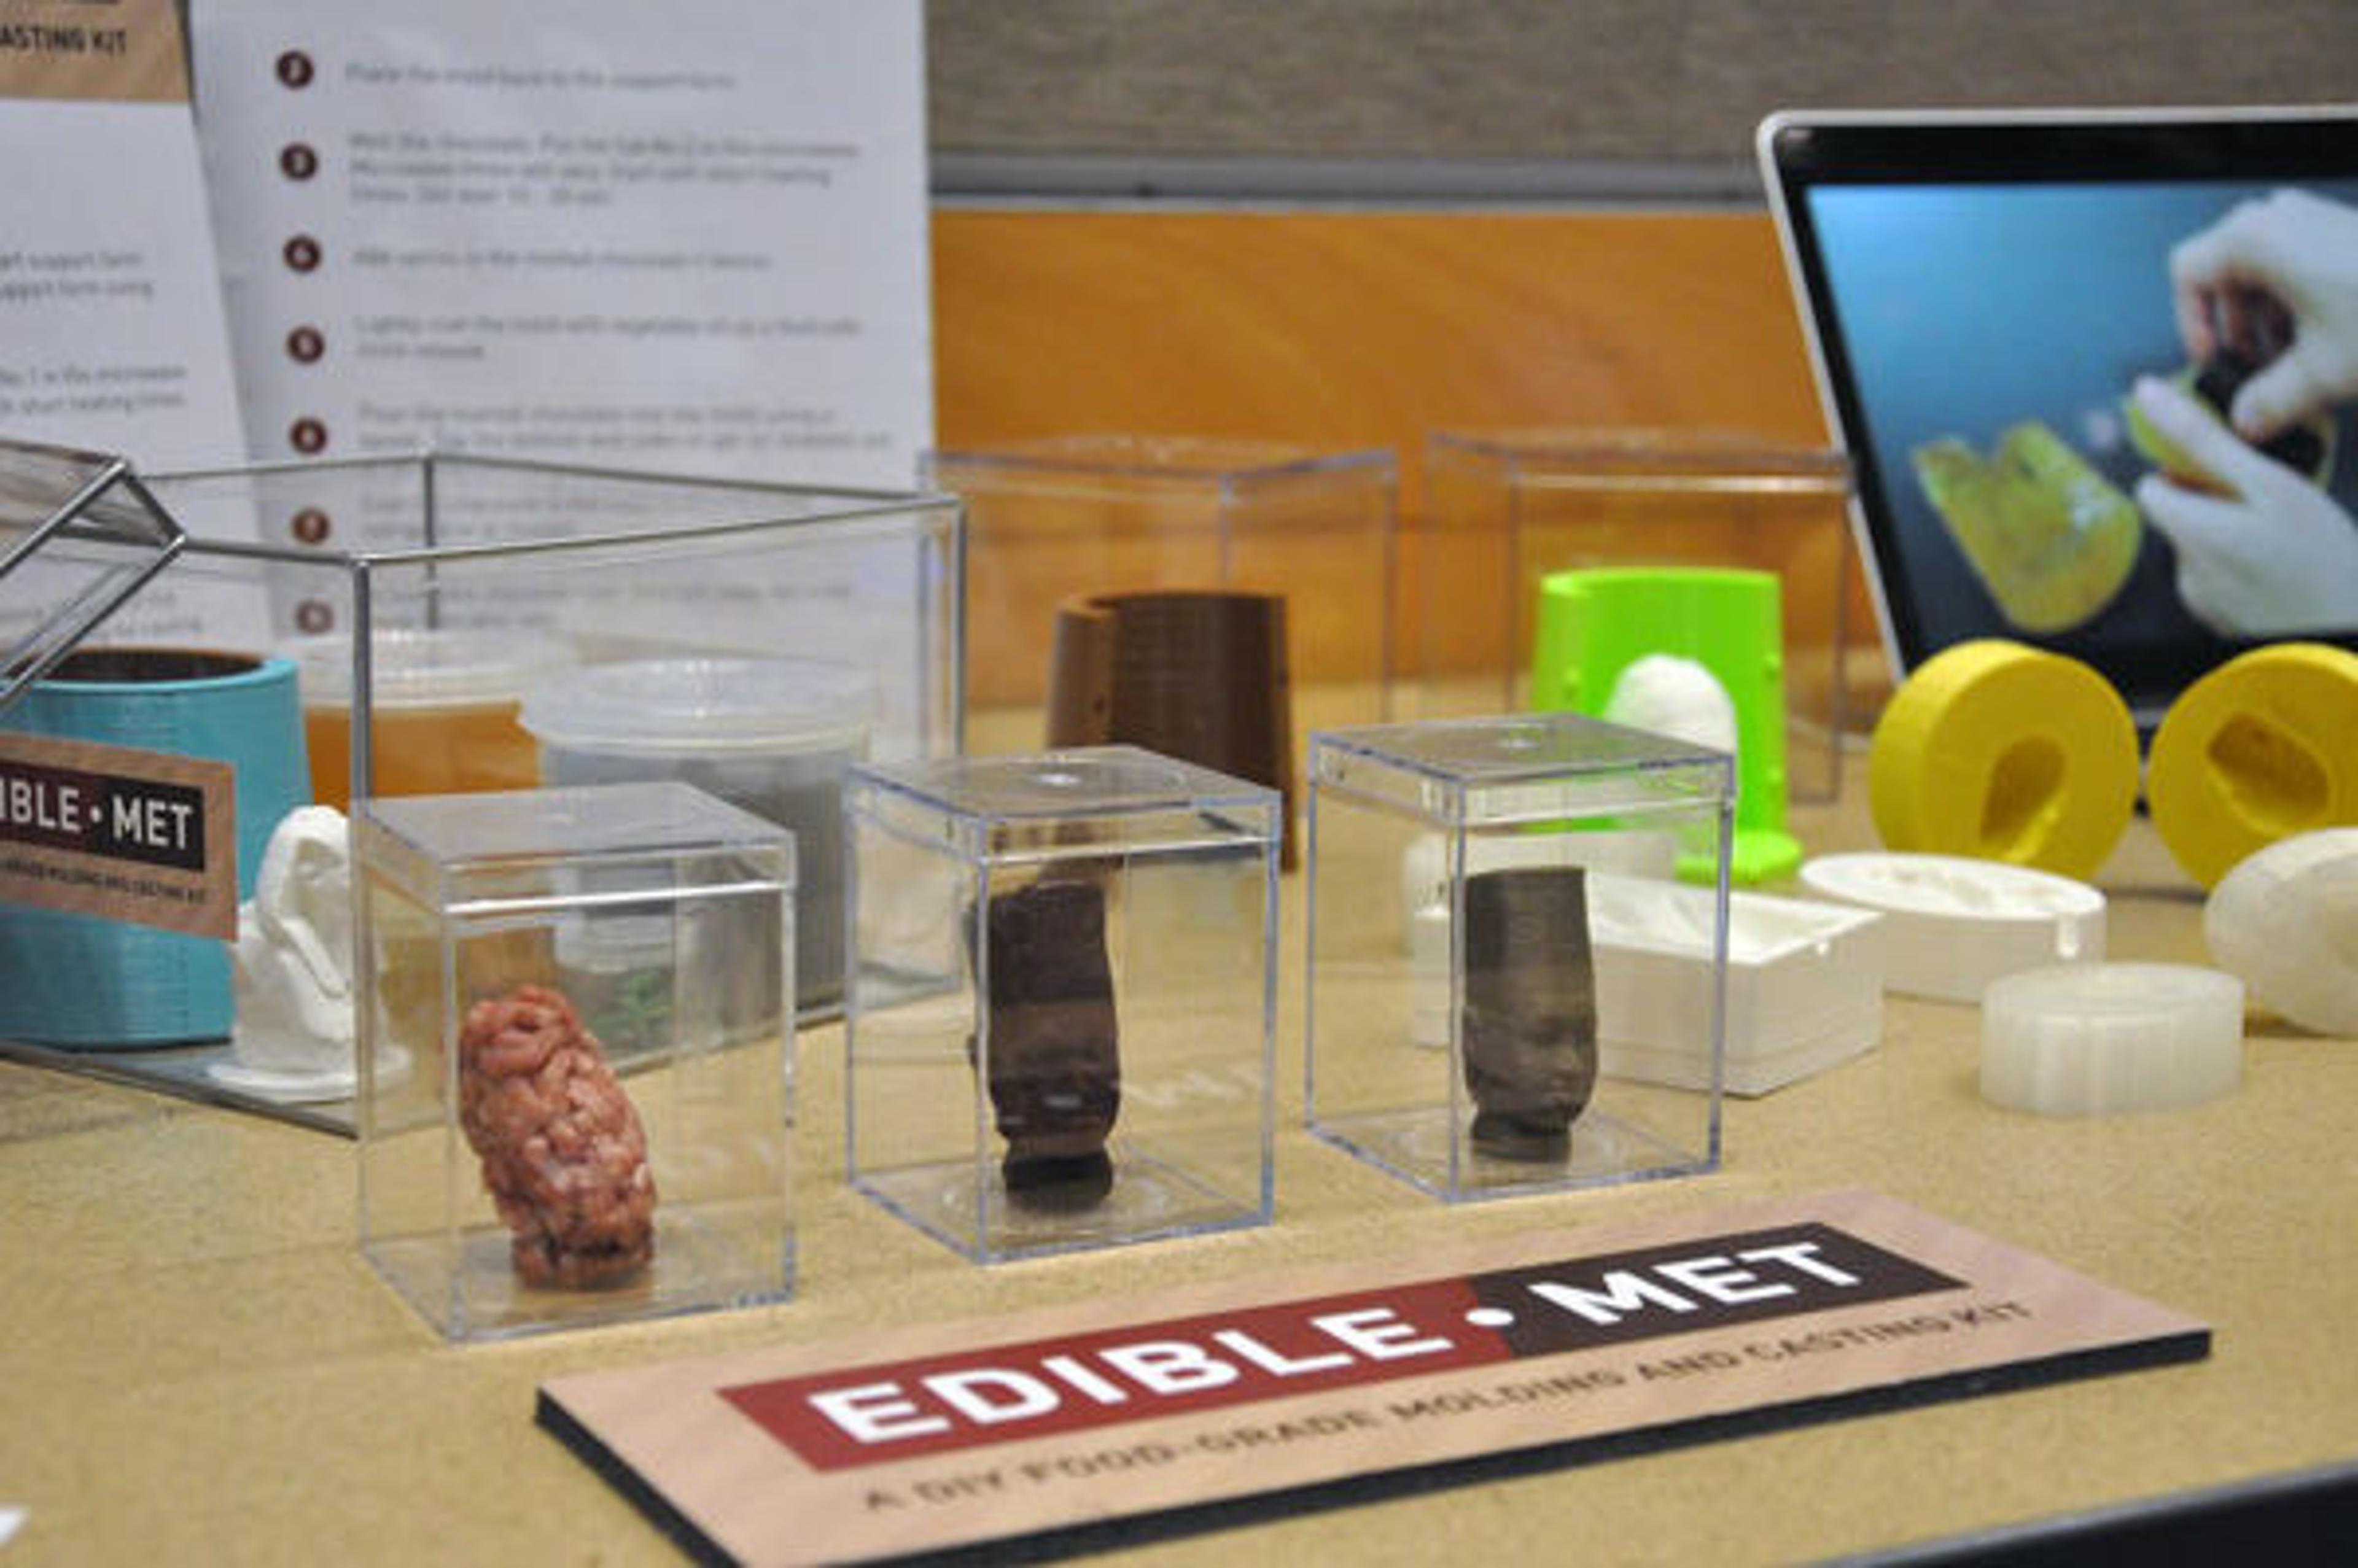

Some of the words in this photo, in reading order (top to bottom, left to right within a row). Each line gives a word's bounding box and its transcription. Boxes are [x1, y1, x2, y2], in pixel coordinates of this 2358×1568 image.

[92, 28, 127, 55] KIT
[112, 794, 193, 850] MET
[806, 1308, 1455, 1444] EDIBLE
[1527, 1241, 1862, 1325] MET
[865, 1488, 905, 1510] A
[912, 1471, 1005, 1504] DIY
[1018, 1408, 1380, 1483] FOOD-GRADE
[1387, 1369, 1627, 1421] MOLDING
[1635, 1349, 1744, 1382] AND
[1745, 1314, 1951, 1363] CASTING
[1953, 1300, 2033, 1335] KIT
